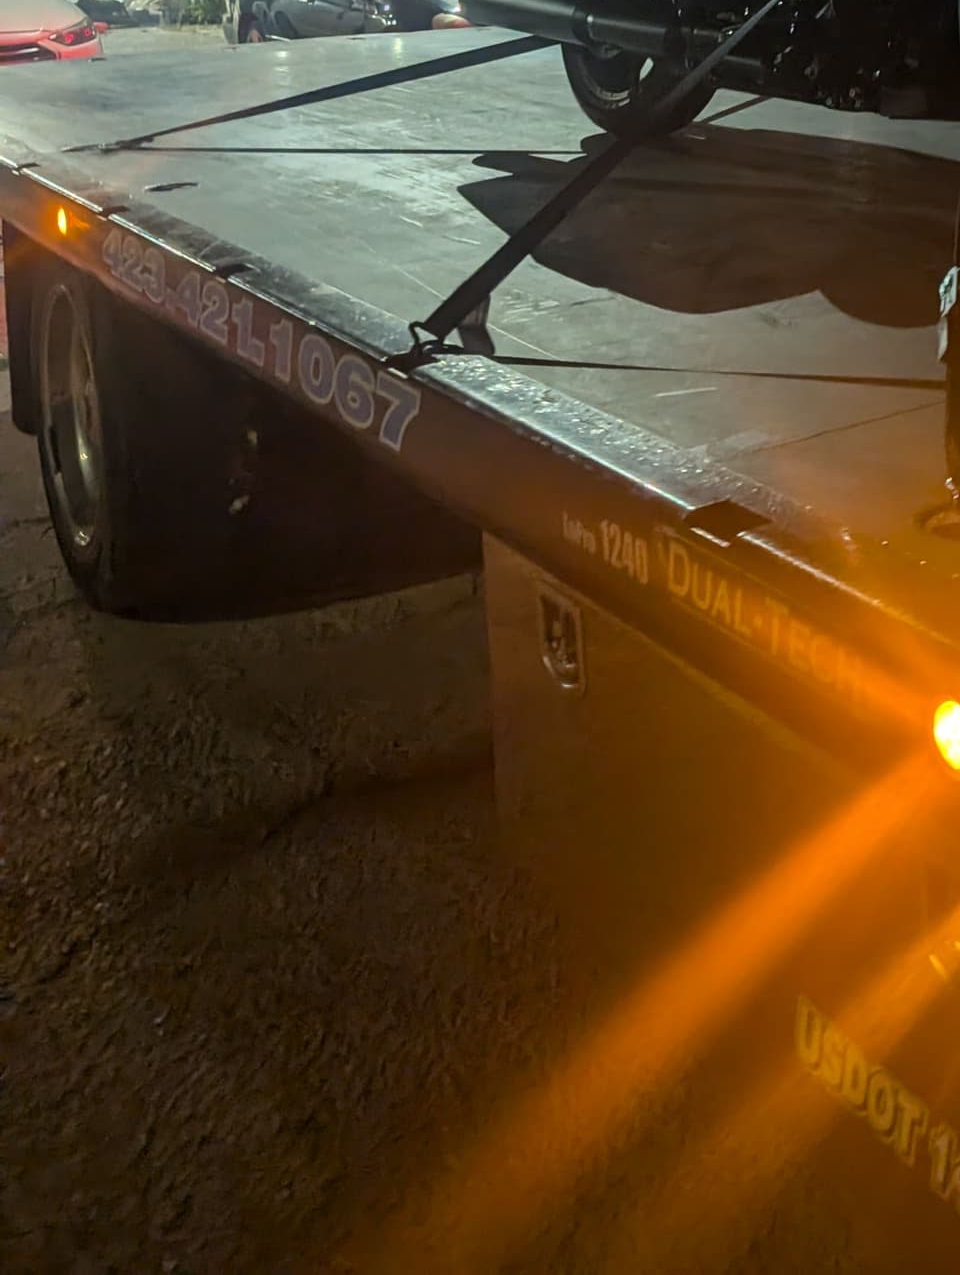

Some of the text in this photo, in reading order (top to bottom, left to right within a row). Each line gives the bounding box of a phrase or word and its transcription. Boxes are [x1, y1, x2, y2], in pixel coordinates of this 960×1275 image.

[101, 228, 422, 453] 423.421.1067
[600, 518, 649, 585] 1240
[796, 995, 930, 1168] USDOT
